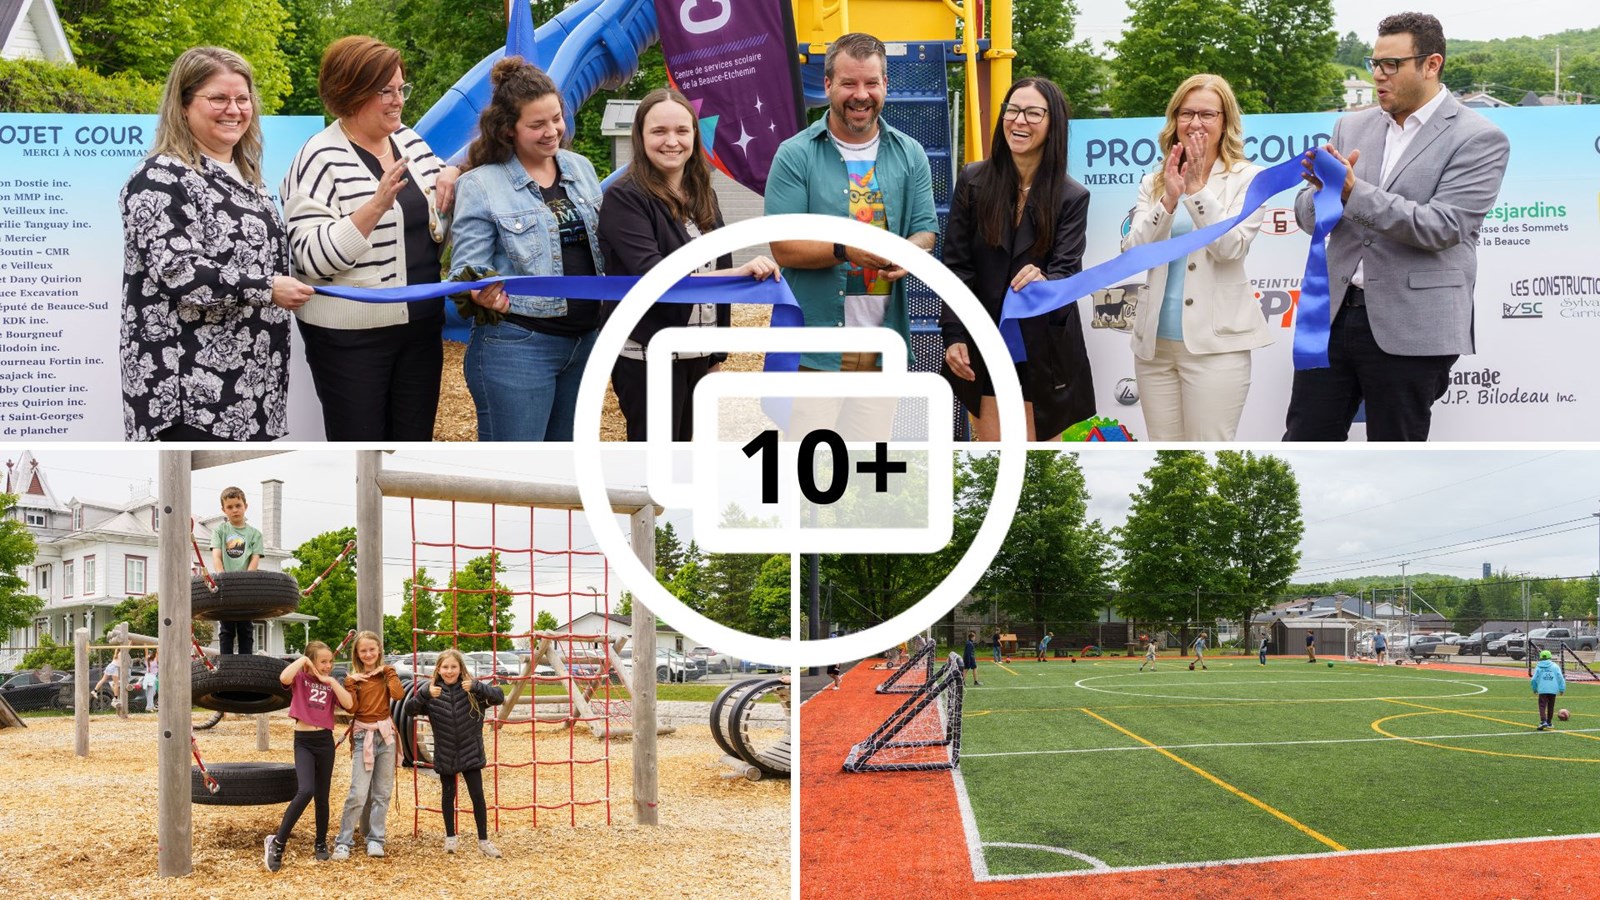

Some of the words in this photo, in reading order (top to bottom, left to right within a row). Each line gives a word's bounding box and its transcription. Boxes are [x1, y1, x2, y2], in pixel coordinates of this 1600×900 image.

[674, 70, 694, 80] Centre
[694, 66, 703, 74] de
[703, 60, 733, 73] services
[734, 53, 762, 66] scolaire
[682, 81, 690, 90] de
[698, 66, 756, 86] Beauce-Etchemin
[75, 126, 144, 145] COUR
[22, 148, 60, 157] MERCI
[62, 146, 71, 157] À
[74, 148, 97, 157] NOS
[1086, 138, 1163, 168] PRO
[15, 179, 49, 187] Dostie
[52, 179, 72, 187] inc.
[1084, 173, 1134, 185] MERCI
[14, 193, 41, 201] MMP
[44, 193, 63, 201] inc.
[3, 206, 46, 214] Veilleux
[49, 206, 68, 214] inc.
[24, 220, 69, 230] Tanguay
[72, 220, 92, 228] inc.
[1502, 224, 1519, 233] des
[1522, 223, 1569, 232] Sommets
[5, 234, 47, 242] Mercier
[1483, 237, 1492, 246] la
[1494, 237, 1530, 246] Beauce
[45, 247, 70, 256] CMR
[10, 261, 53, 270] Veilleux
[10, 275, 37, 285] Dany
[40, 275, 82, 285] Quirion
[20, 288, 79, 297] Excavation
[1510, 279, 1529, 297] LES
[31, 302, 44, 310] de
[47, 301, 109, 310] Beauce-Sud
[1521, 302, 1543, 314] SC
[3, 317, 26, 325] KDK
[29, 316, 49, 325] inc.
[6, 329, 63, 340] Bourgneuf
[40, 343, 60, 352] inc.
[49, 357, 81, 366] Fortin
[85, 356, 104, 365] inc.
[37, 371, 57, 379] inc.
[22, 384, 66, 393] Cloutier
[69, 384, 88, 392] inc.
[1440, 389, 1469, 405] J.P.
[1478, 387, 1549, 405] Bilodeau
[1556, 391, 1577, 403] Inc.
[22, 398, 64, 408] Quirion
[67, 397, 87, 406] inc.
[8, 412, 84, 422] Saint-Georges
[3, 427, 17, 435] de
[20, 425, 69, 437] plancher
[309, 689, 328, 704] 22
